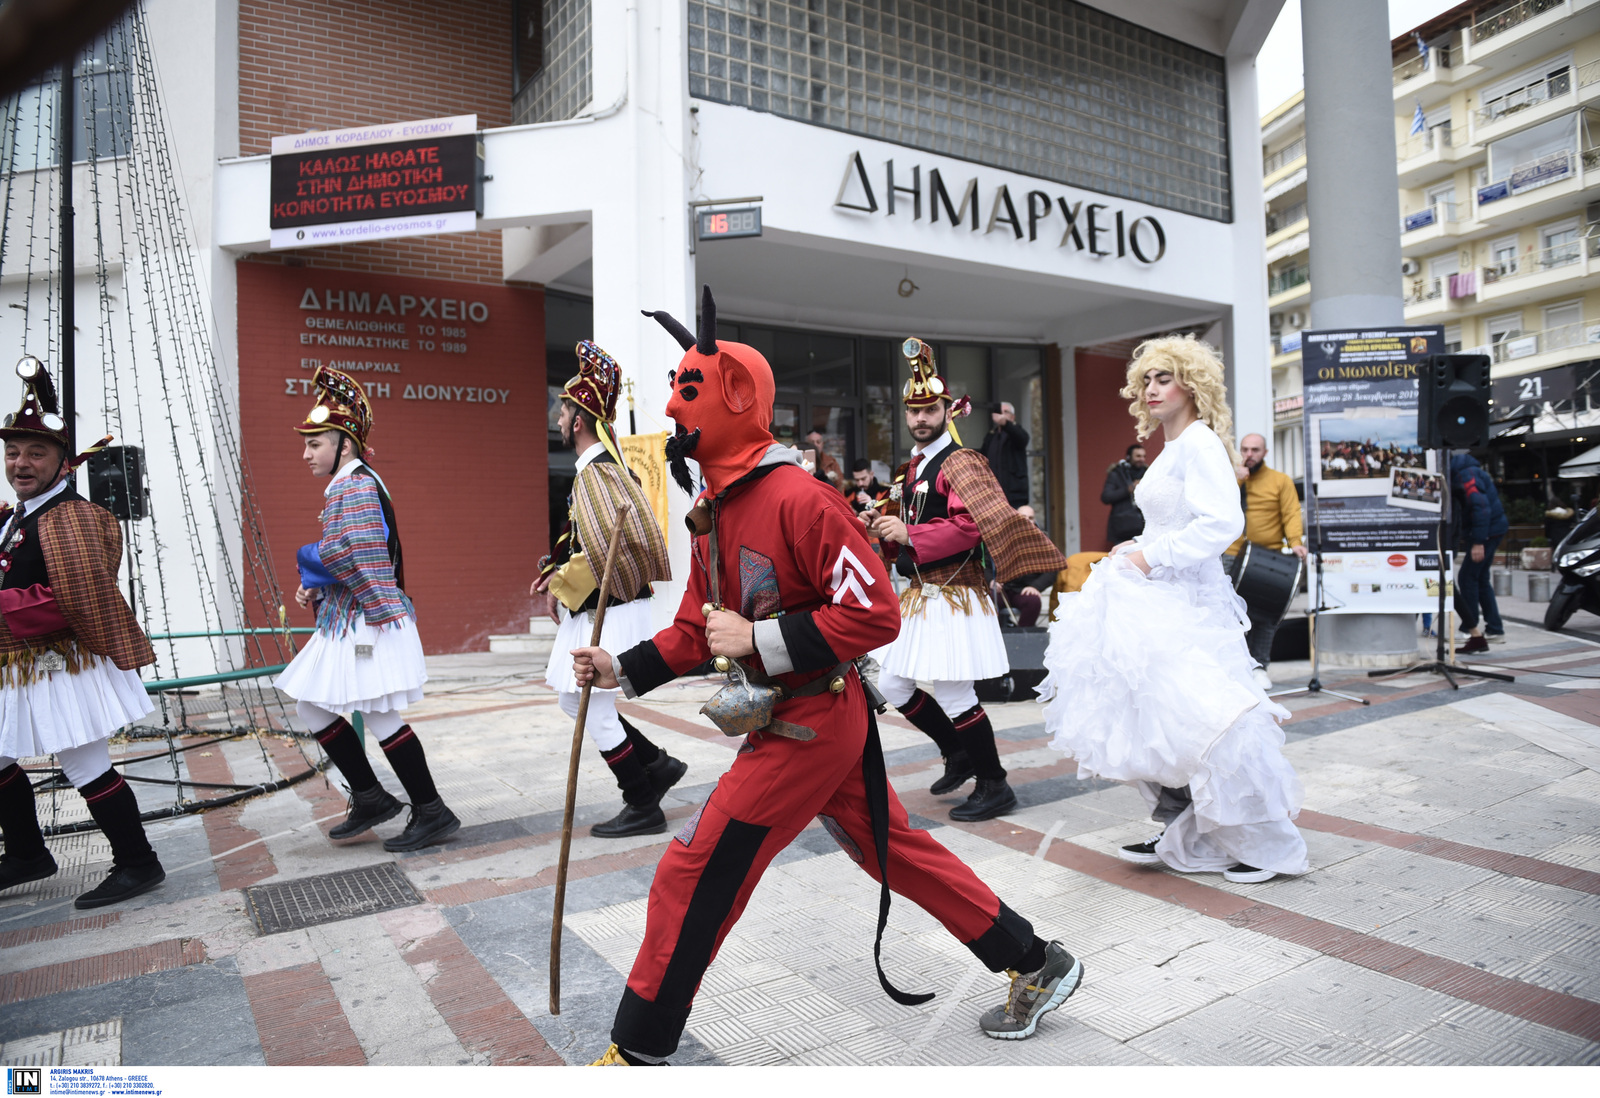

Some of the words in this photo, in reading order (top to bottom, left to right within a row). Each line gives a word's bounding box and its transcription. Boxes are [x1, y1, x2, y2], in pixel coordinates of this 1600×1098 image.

[294, 137, 329, 149] ΔΗΜΟΣ
[335, 128, 393, 144] ΚΟΡΔΕΛΙΟΥ
[402, 122, 454, 137] ΕΥΟΣΜΟΥ
[300, 155, 361, 177] ΚΑΛΩΣ
[365, 146, 440, 171] ΗΛΘΑΤΕ
[296, 177, 342, 196] ΣΤΗΝ
[347, 165, 444, 192] ΔΗΜΟΤΙΚΗ
[273, 194, 376, 218] ΚΟΙΝΟΤΗΤΑ
[380, 184, 469, 209] ΕΥΟΣΜΟΥ
[833, 150, 1167, 265] ΔΗΜΑΡΧΕΙΟ
[312, 218, 447, 239] www.kordelio-evosmos.gr
[710, 214, 728, 233] 16
[299, 287, 489, 323] ΔΗΜΑΡΧΕΙΟ
[305, 316, 406, 334] ΘΕΜΕΛΙΩΘΗΚΕ
[417, 324, 436, 336] ΤΟ
[441, 327, 467, 338] 1985
[300, 333, 410, 350] ΕΓΚΑΙΝΙΑΣΤΗΚΕ
[417, 340, 435, 351] ΤΟ
[441, 342, 467, 353] 1989
[300, 358, 321, 369] ΕΠΙ
[329, 360, 401, 373] ΔΗΜΑΡΧΙΑΣ
[402, 384, 511, 404] ΔΙΟΝΥΣΙΟΥ
[1398, 390, 1419, 400] 2019
[1519, 376, 1542, 399] 21
